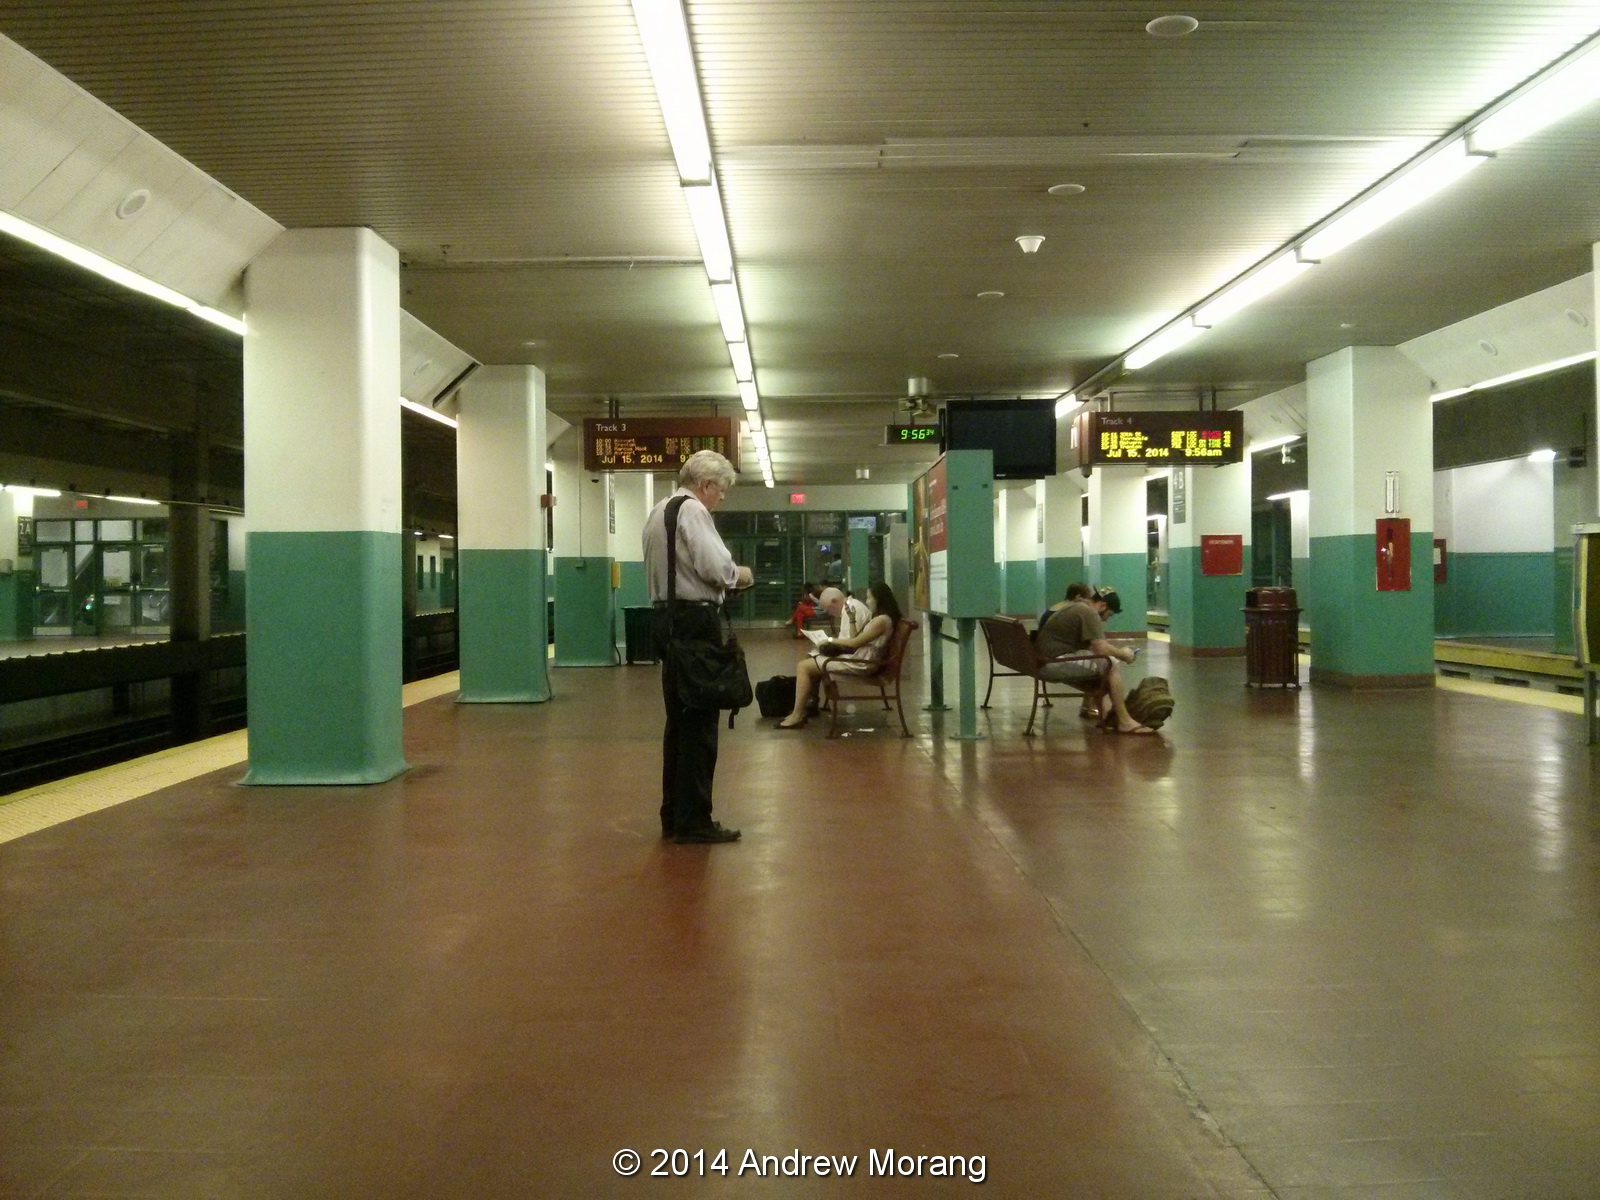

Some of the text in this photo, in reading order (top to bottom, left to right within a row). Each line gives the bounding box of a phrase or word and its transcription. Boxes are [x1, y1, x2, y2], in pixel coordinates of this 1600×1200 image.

[1101, 417, 1132, 425] Track 4
[595, 423, 627, 432] Track 3
[901, 429, 926, 440] 9:56
[1106, 448, 1122, 458] Jul
[1145, 448, 1169, 458] 2014
[1185, 449, 1222, 457] 9:56am
[601, 456, 616, 464] Jul
[640, 455, 663, 464] 2014
